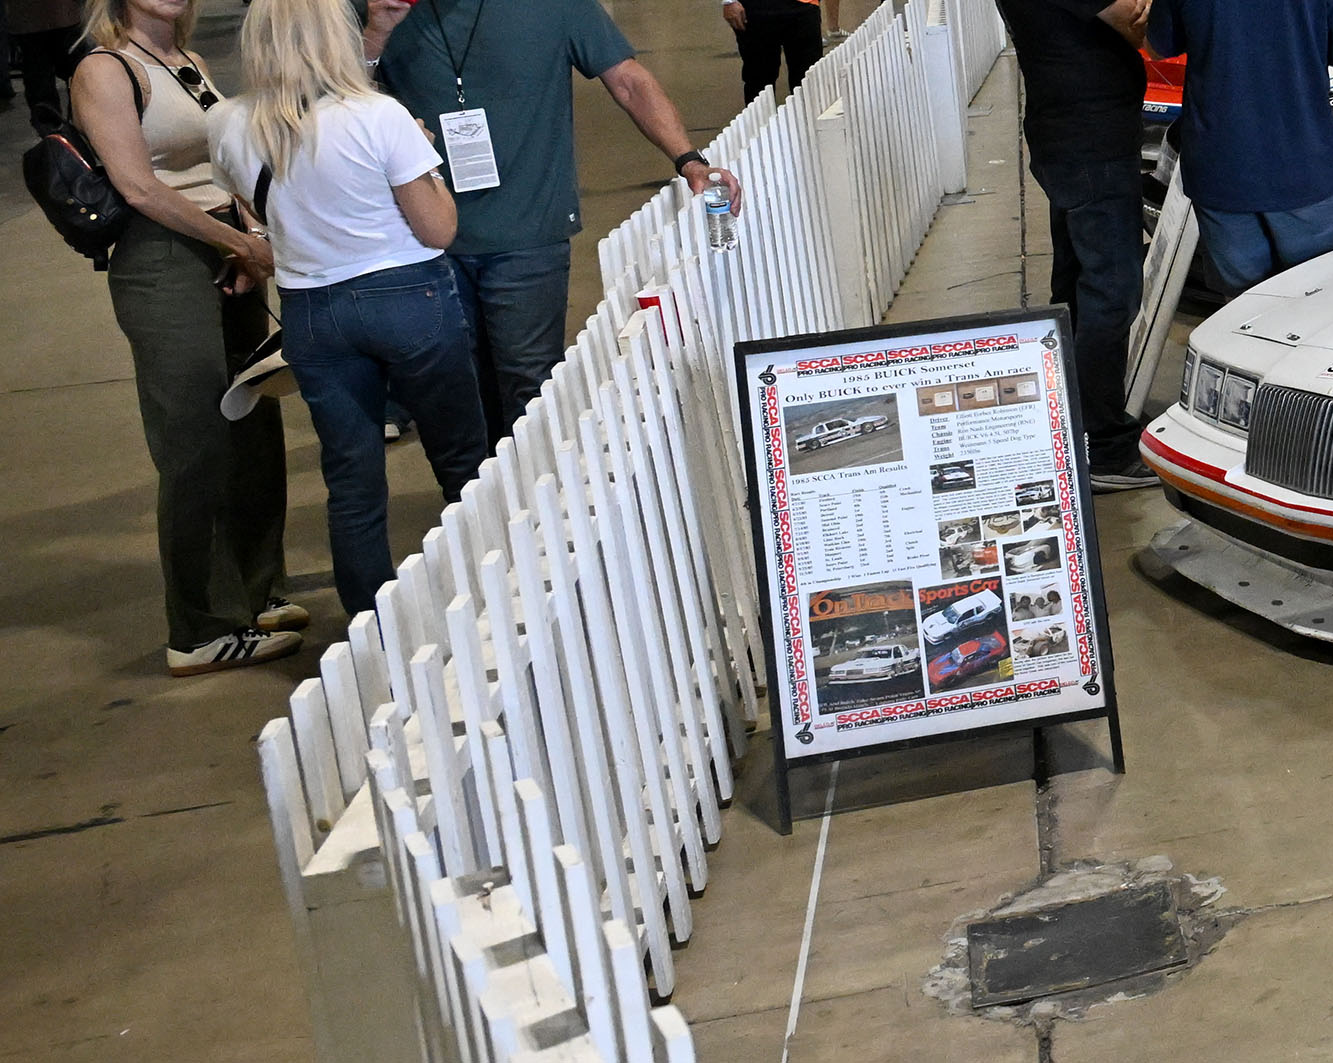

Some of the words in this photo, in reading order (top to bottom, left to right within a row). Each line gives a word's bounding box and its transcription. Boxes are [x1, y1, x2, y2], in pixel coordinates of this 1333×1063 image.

[797, 369, 817, 377] PRO
[843, 364, 860, 372] PRO
[798, 357, 840, 371] SCCA
[843, 352, 885, 366] SCCA
[887, 347, 929, 362] SCCA
[931, 341, 973, 356] SCCA
[975, 336, 1017, 351] SCCA
[843, 374, 870, 384] 1985
[875, 368, 915, 380] BUICK
[919, 362, 976, 375] Somerset
[785, 394, 818, 404] Only
[818, 388, 859, 401] BUICK
[882, 383, 905, 393] ever
[911, 379, 926, 388] win
[948, 372, 981, 383] Trans
[984, 370, 1002, 378] Am
[1008, 366, 1032, 375] race
[765, 386, 779, 425] SCCA
[769, 427, 783, 466] SCCA
[774, 469, 788, 509] SCCA
[791, 477, 810, 485] 1985
[812, 474, 836, 483] SCCA
[834, 471, 858, 479] Trans
[860, 468, 876, 476] Am
[879, 464, 908, 473] Results
[779, 511, 792, 551] SCCA
[1063, 513, 1075, 551] SCCA
[784, 553, 797, 594] SCCA
[918, 583, 969, 605] Sports
[970, 578, 1001, 593] Car
[1067, 553, 1080, 592] SCCA
[788, 596, 801, 636] SCCA
[812, 595, 849, 617] On
[1071, 595, 1085, 634] SCCA
[792, 638, 805, 679] SCCA
[1077, 636, 1090, 675] SCCA
[797, 681, 810, 722] SCCA
[838, 710, 880, 724] SCCA
[881, 701, 925, 716] SCCA
[927, 696, 969, 709] SCCA
[971, 687, 1014, 701] SCCA
[1016, 680, 1059, 693] SCCA
